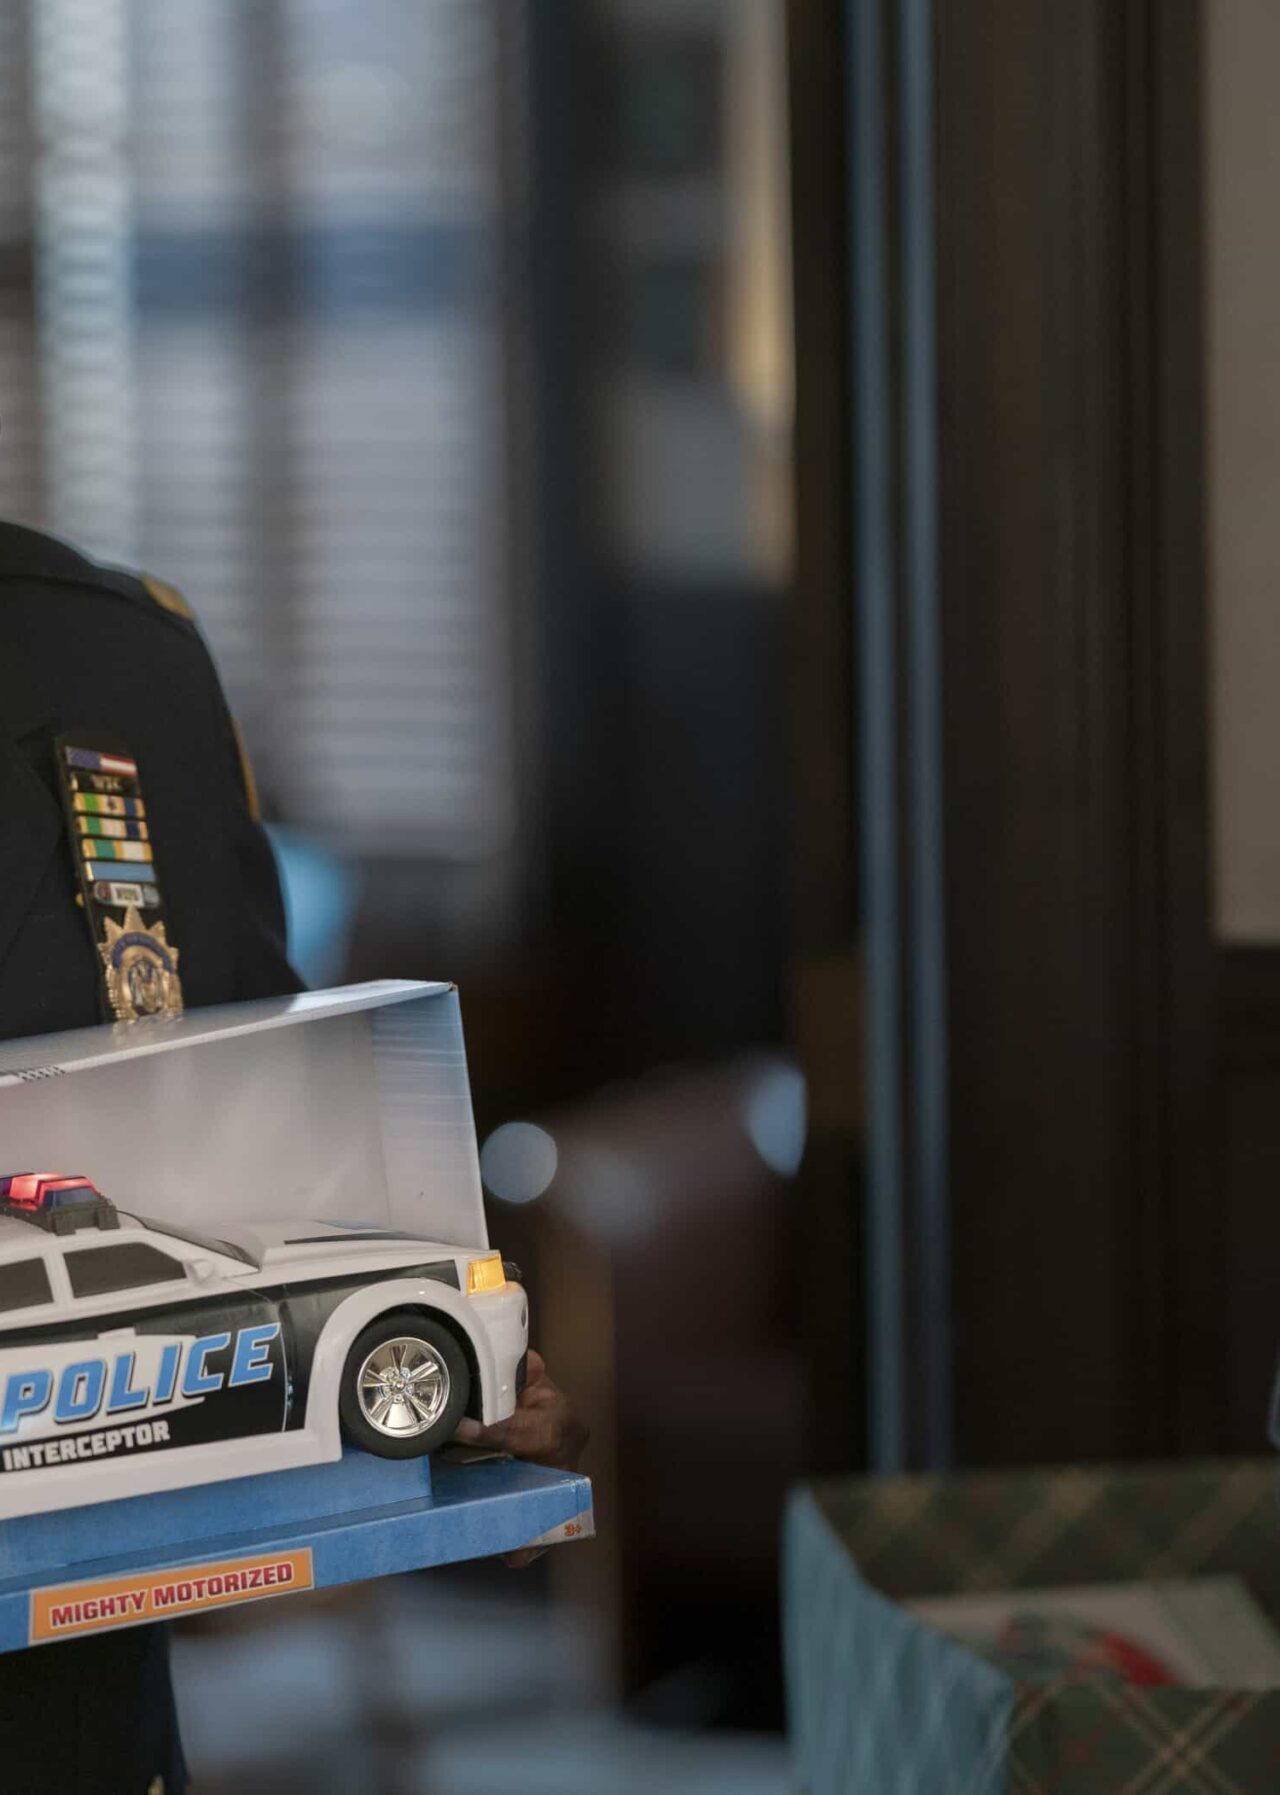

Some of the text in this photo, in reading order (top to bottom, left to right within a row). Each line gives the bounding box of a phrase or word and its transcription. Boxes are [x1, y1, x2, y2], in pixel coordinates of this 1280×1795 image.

[2, 1420, 171, 1471] INTERCEPTOR
[49, 1562, 294, 1629] MIGHTY MOTORIZED
